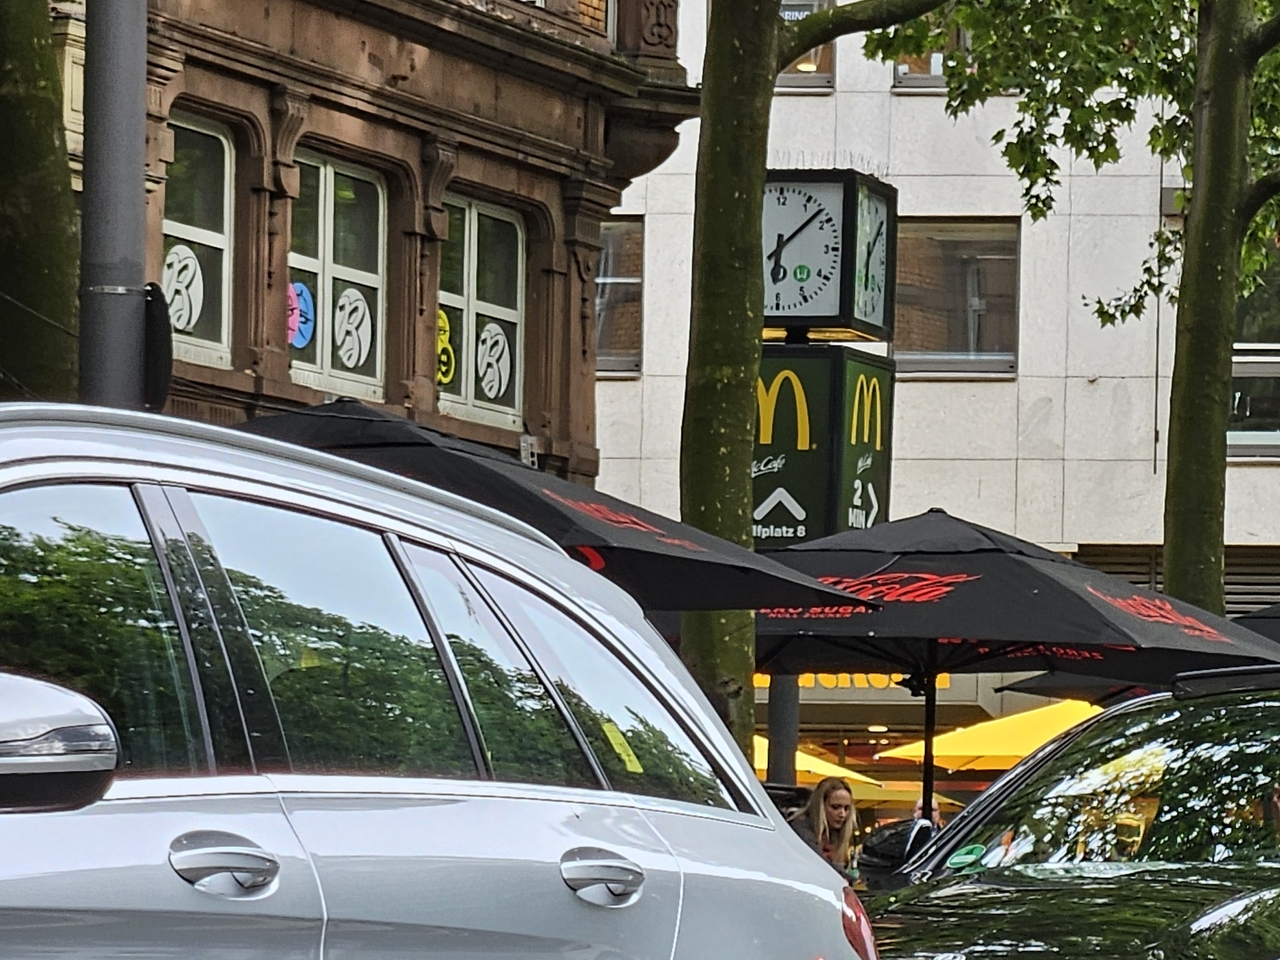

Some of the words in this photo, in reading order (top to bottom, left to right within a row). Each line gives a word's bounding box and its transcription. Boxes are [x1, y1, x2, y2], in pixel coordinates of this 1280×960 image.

[776, 196, 788, 206] 12
[818, 220, 825, 230] 2
[823, 244, 830, 254] 3
[775, 292, 781, 302] 6
[853, 479, 862, 506] 2
[848, 507, 866, 529] MIN
[751, 524, 795, 539] lfplatz
[796, 525, 806, 537] 8
[809, 606, 867, 614] SUGA
